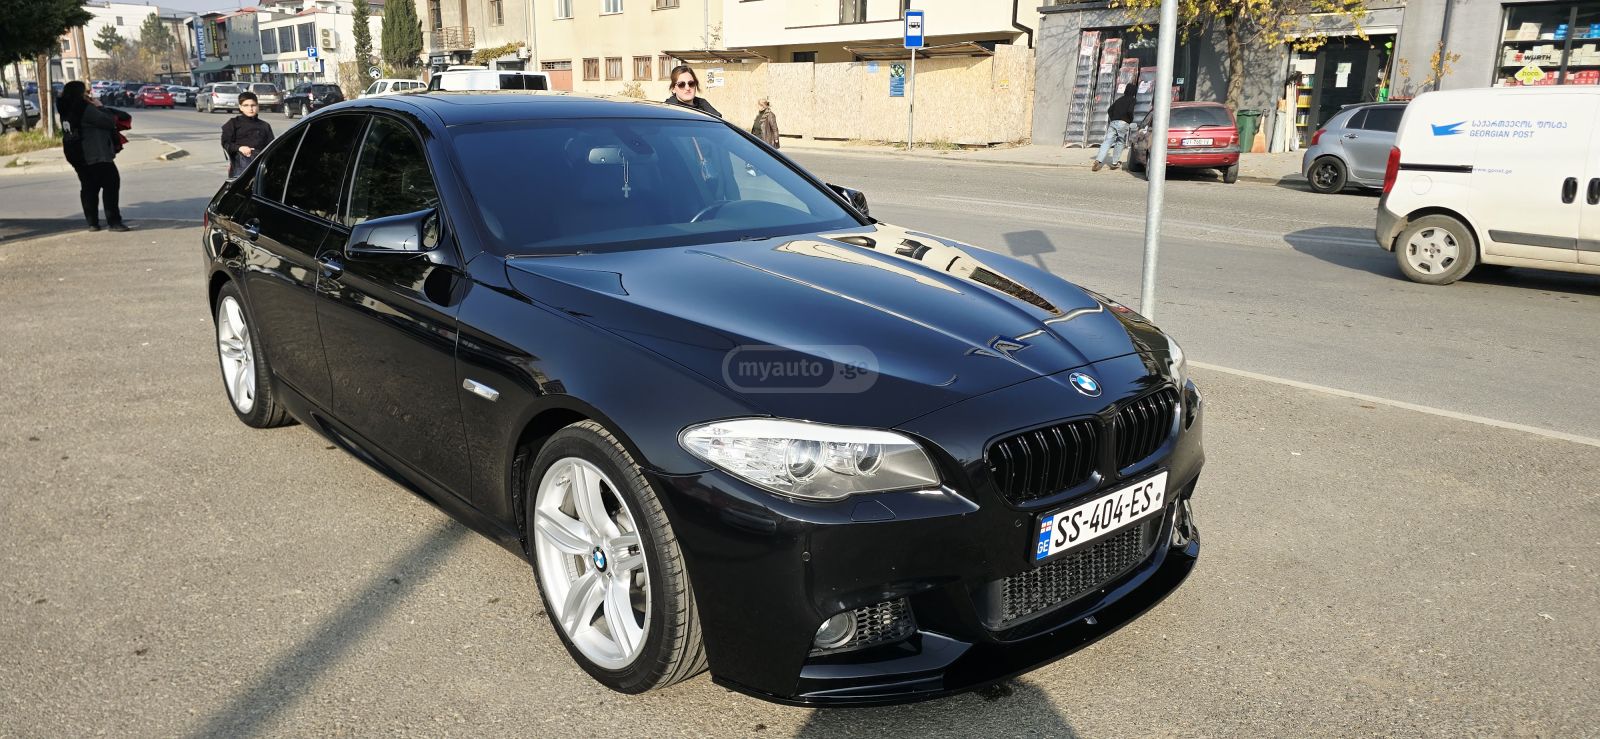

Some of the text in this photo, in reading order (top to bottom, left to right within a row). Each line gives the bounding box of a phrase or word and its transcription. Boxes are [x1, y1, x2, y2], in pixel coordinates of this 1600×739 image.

[197, 27, 206, 59] PAULANER
[1469, 129, 1535, 138] GEORGIAN POST
[1037, 482, 1153, 554] GE SS-404-ES
